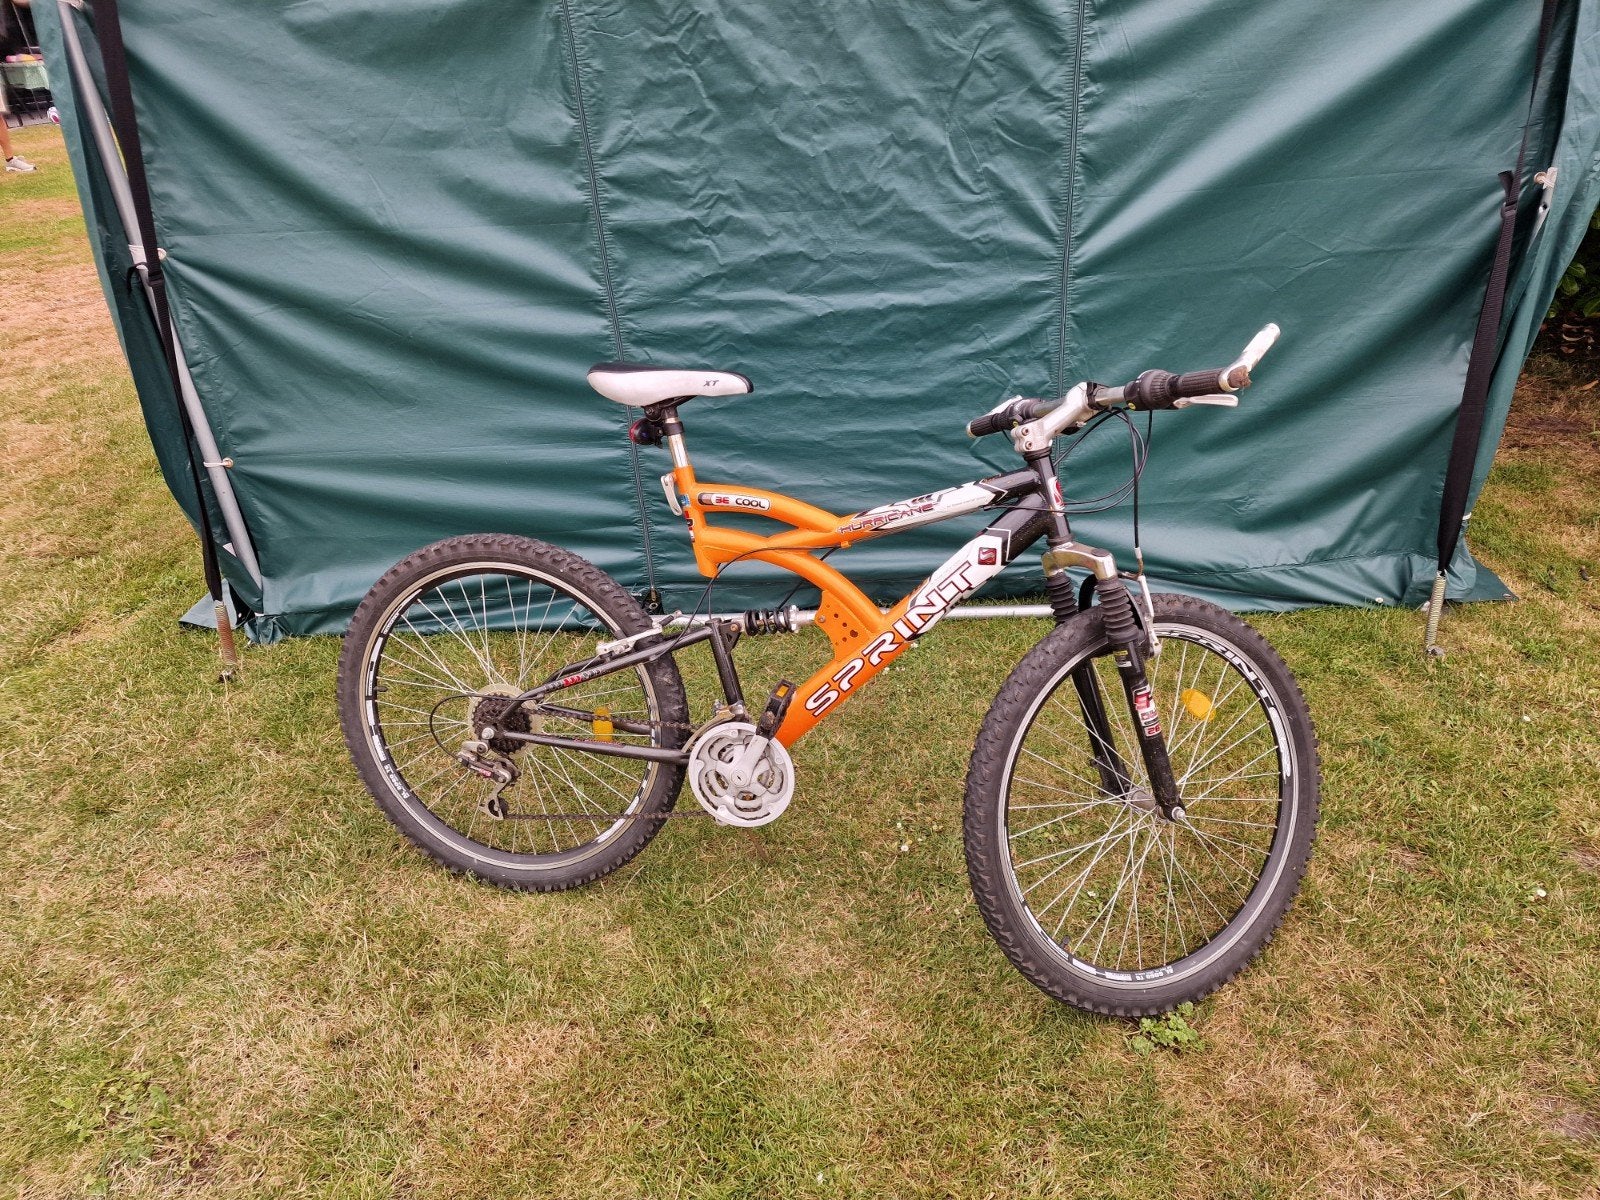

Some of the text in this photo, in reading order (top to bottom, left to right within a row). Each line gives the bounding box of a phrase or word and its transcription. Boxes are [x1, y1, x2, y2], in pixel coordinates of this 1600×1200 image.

[703, 379, 720, 387] XT
[735, 497, 767, 509] COOL
[840, 502, 935, 534] HURRICANE
[805, 560, 972, 718] SPRINT
